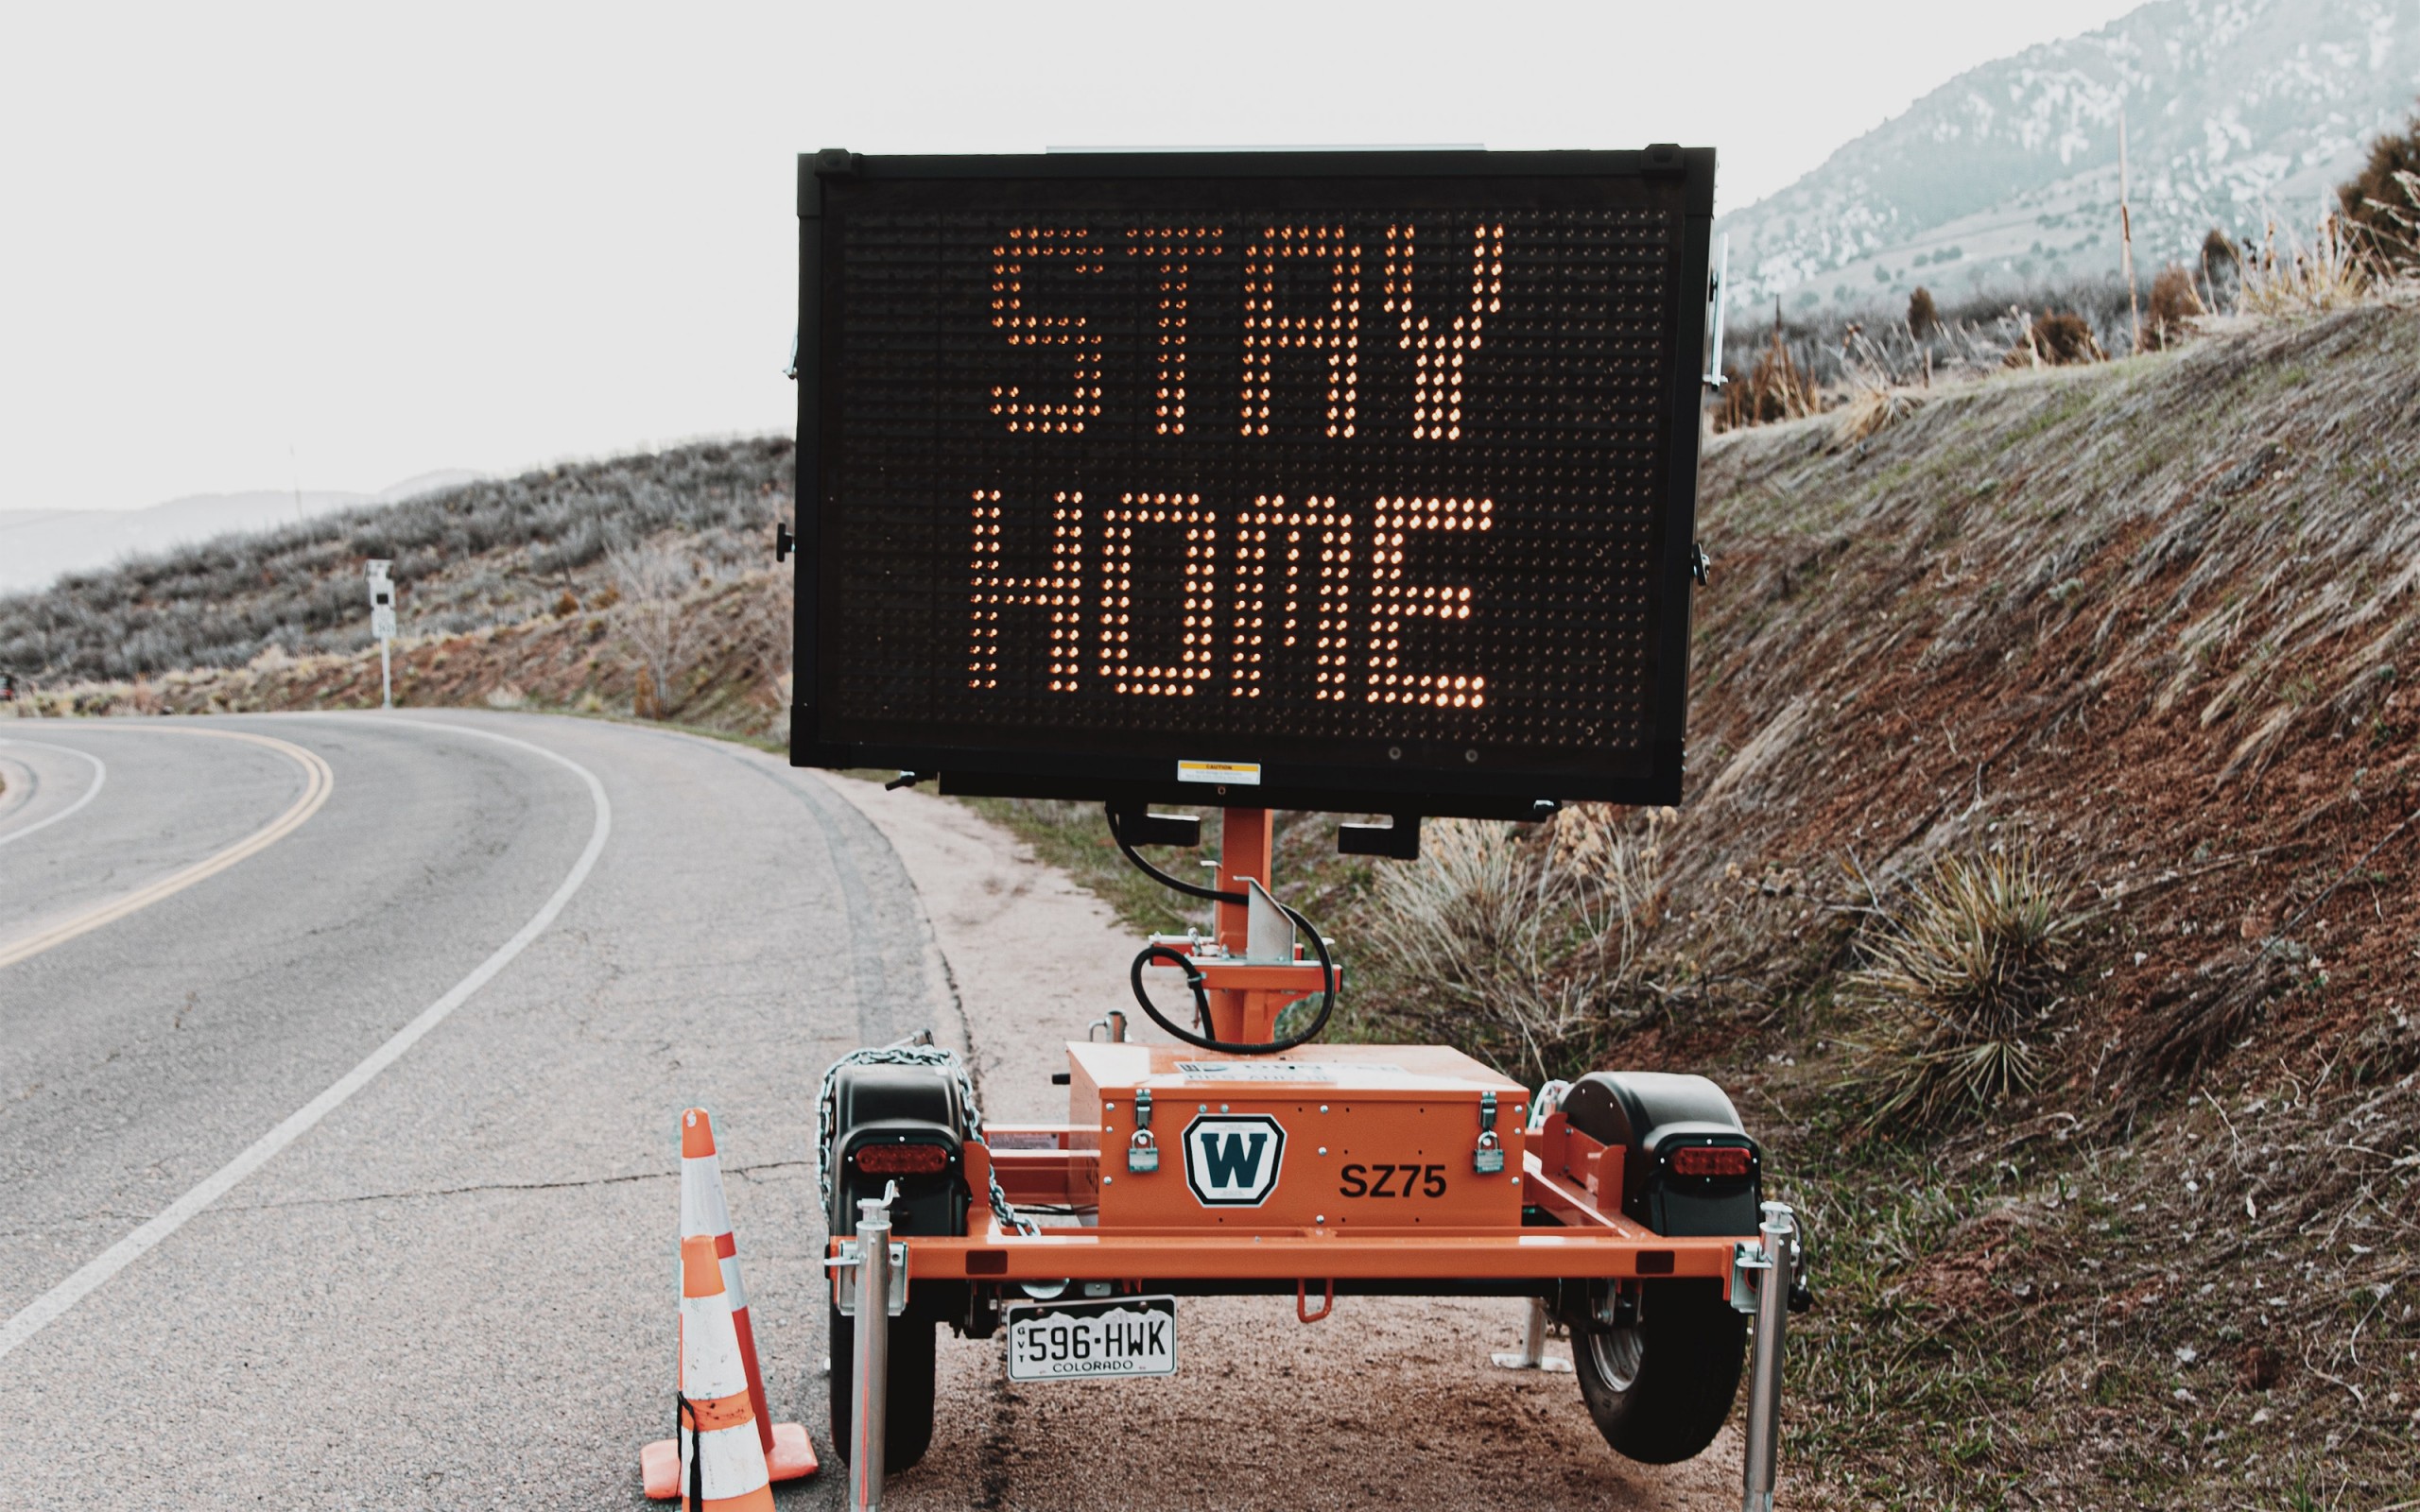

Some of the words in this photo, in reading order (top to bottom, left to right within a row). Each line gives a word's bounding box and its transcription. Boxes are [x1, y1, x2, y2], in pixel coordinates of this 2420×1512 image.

[990, 223, 1506, 440] STAY
[969, 488, 1495, 709] HOME
[1205, 763, 1233, 771] CAUTION
[1200, 1131, 1268, 1189] W
[1339, 1163, 1446, 1199] SZ75
[1052, 1360, 1133, 1373] COLORADO
